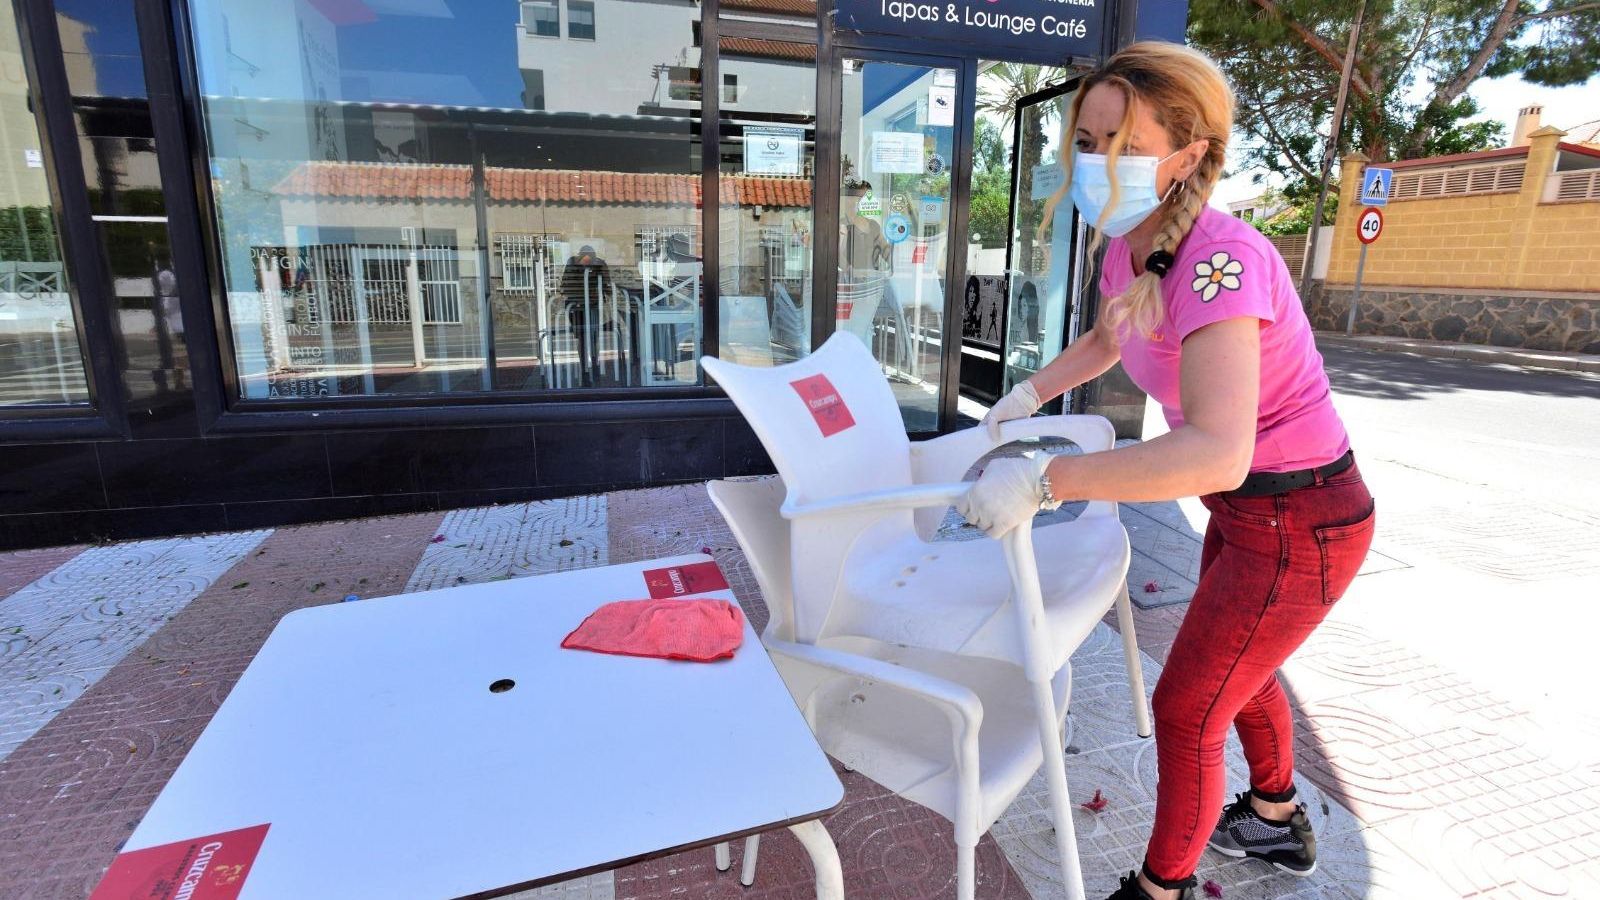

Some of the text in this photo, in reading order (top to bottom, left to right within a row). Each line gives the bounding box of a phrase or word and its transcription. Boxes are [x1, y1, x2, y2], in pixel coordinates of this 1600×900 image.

[882, 0, 1087, 39] Tapas & Lounge Café
[1363, 220, 1378, 231] 40
